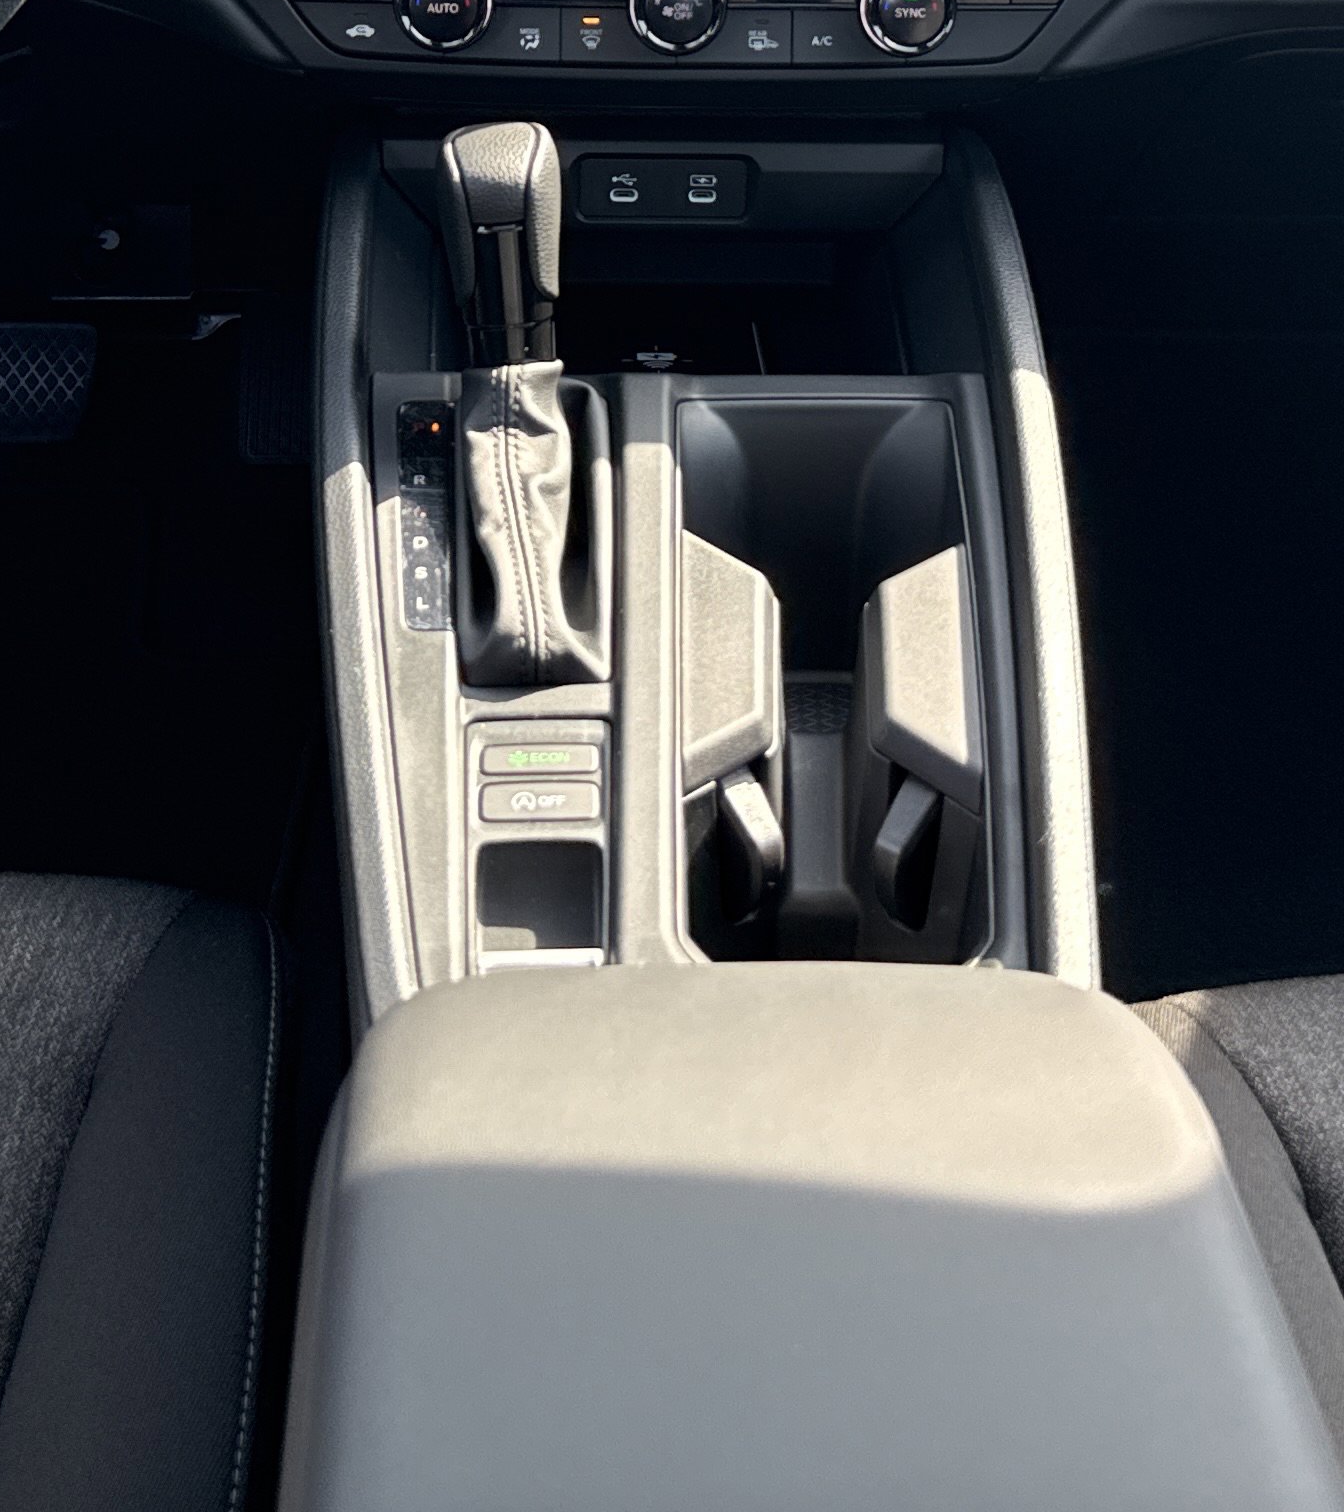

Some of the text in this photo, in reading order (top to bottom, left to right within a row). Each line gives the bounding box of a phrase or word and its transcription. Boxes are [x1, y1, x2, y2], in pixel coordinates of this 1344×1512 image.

[427, 2, 459, 13] AUTO
[895, 7, 927, 19] SYNC
[674, 11, 694, 21] OFF
[811, 36, 833, 47] A/C
[413, 474, 426, 485] R
[413, 536, 429, 549] D
[414, 566, 428, 580] S
[416, 596, 430, 610] L
[529, 751, 571, 763] ECON
[537, 794, 567, 808] OFF
